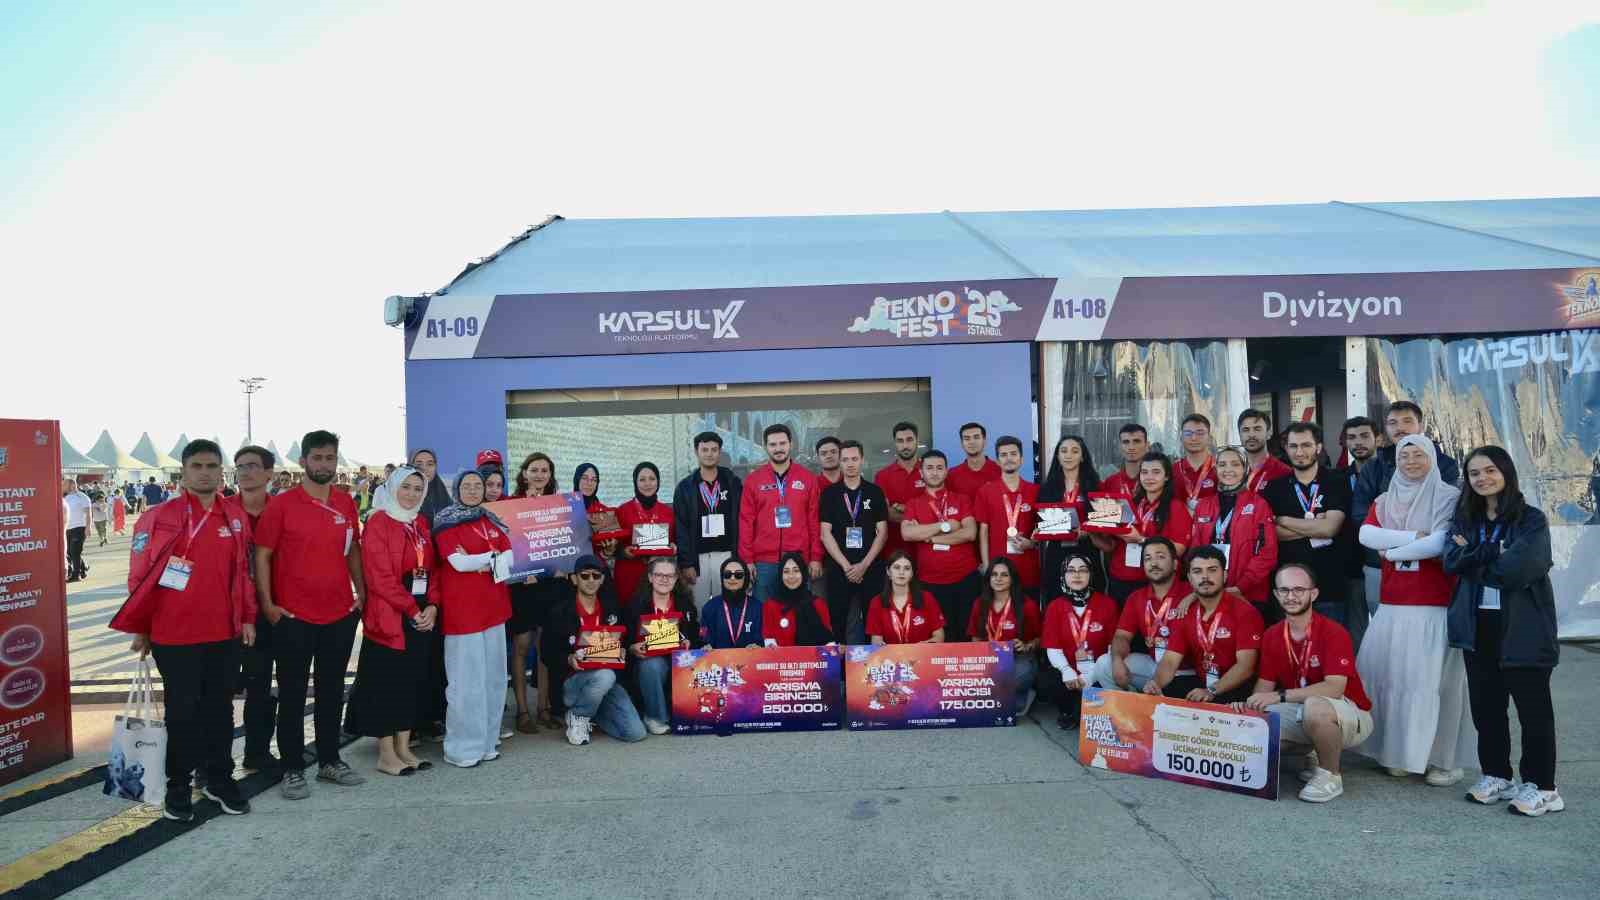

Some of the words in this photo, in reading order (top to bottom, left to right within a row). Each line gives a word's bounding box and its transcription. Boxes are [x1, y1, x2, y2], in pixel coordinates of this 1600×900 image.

[1052, 299, 1107, 319] A1-08
[426, 316, 479, 338] A1-09
[896, 313, 955, 338] FEST
[528, 546, 576, 561] 120.000
[763, 704, 822, 714] 250.000
[940, 700, 995, 710] 175.000
[1166, 753, 1234, 780] 150.000
